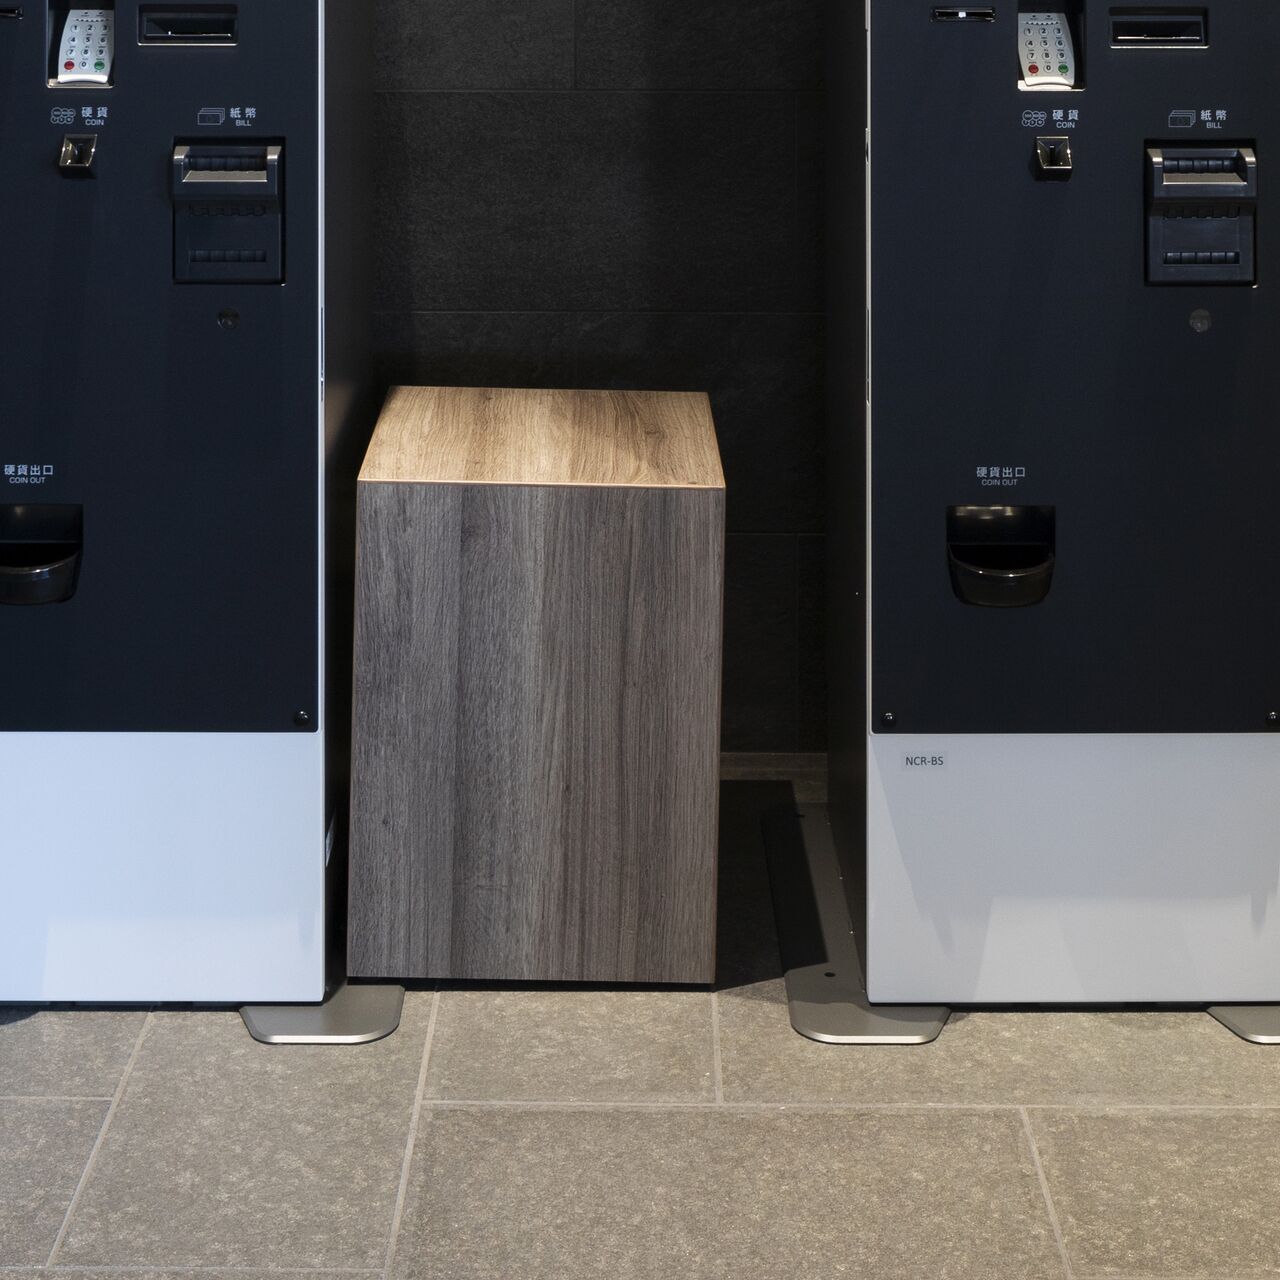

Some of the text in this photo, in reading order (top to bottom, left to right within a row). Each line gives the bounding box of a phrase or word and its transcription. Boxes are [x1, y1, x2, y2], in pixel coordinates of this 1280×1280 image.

[85, 118, 105, 126] COIN
[235, 119, 252, 127] BILL
[1056, 121, 1076, 129] COIN
[1206, 121, 1223, 129] BILL
[4, 464, 54, 476] 硬貨出口
[976, 466, 1026, 478] 硬貨出口
[9, 476, 46, 484] COIN OUT
[981, 478, 1018, 486] COIN OUT
[905, 756, 944, 766] NCR-BS
